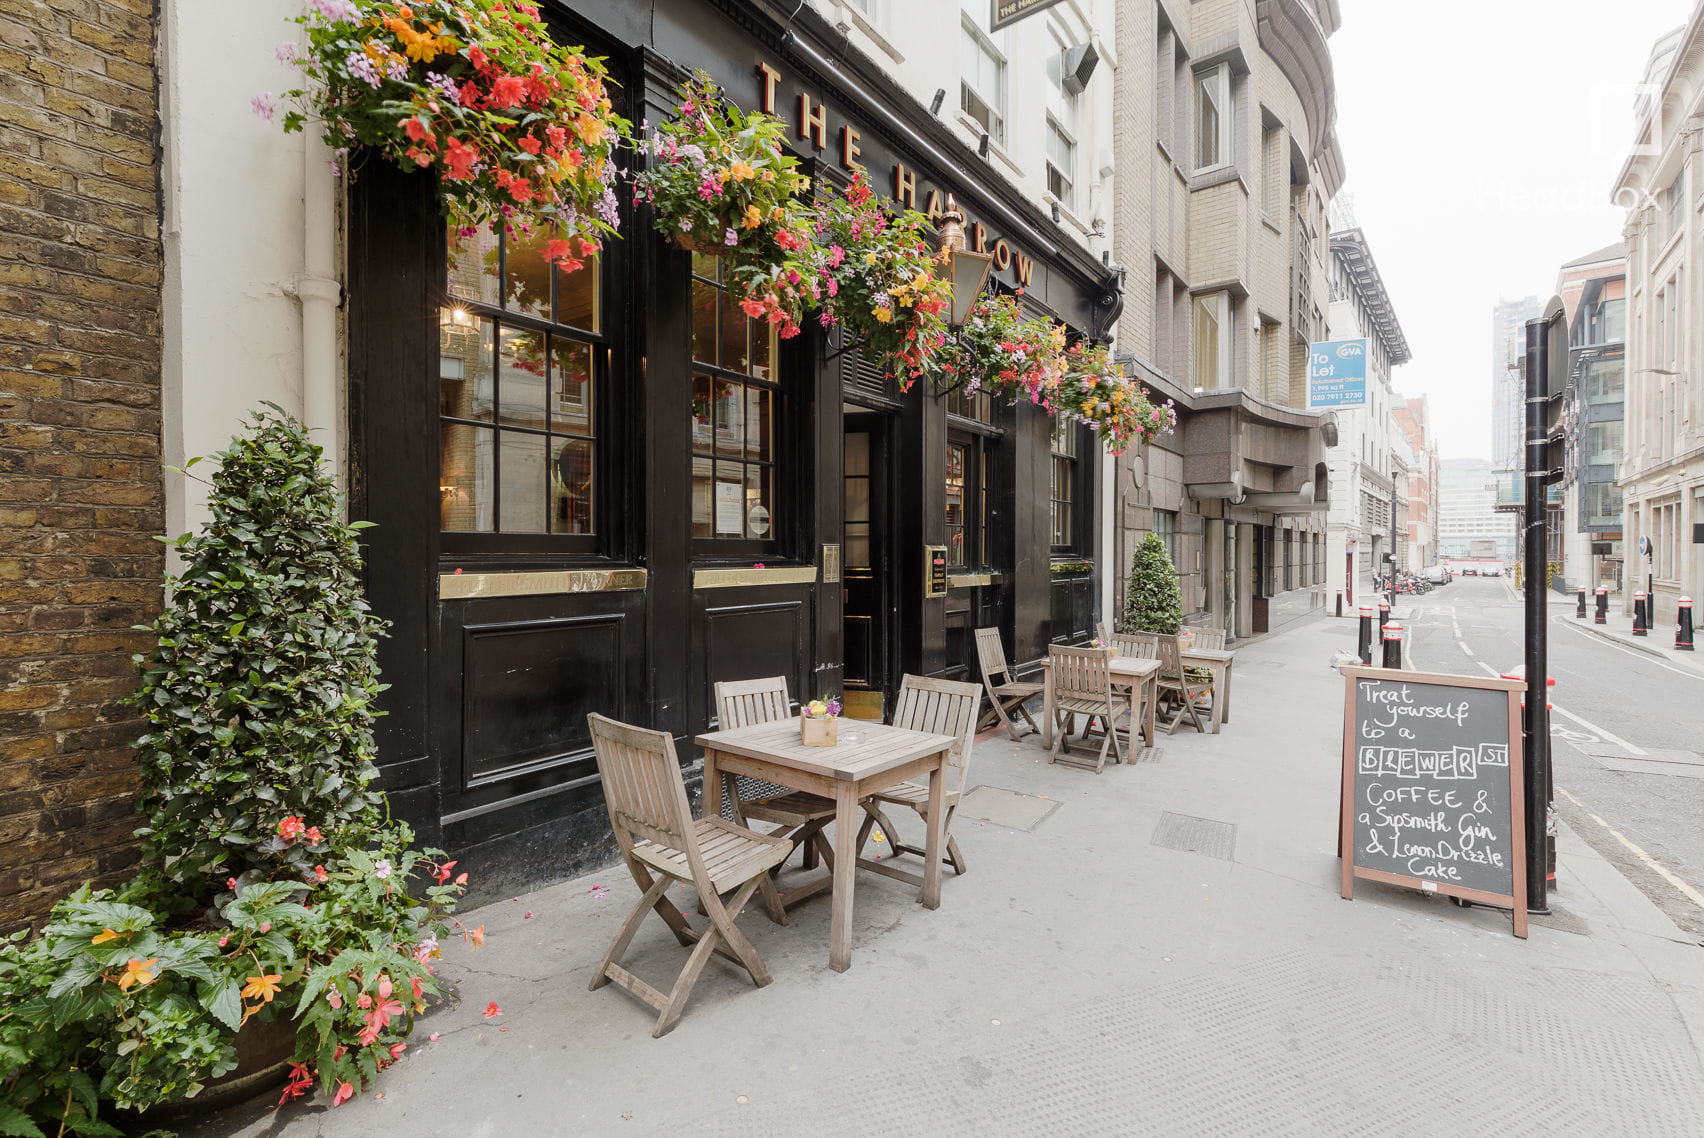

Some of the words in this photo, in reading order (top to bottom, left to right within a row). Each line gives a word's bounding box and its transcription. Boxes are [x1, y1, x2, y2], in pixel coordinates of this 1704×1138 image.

[1000, 3, 1017, 18] THE
[759, 61, 862, 170] THE
[1312, 353, 1329, 365] To
[1312, 364, 1335, 377] Let
[1360, 680, 1414, 704] Treat
[1374, 702, 1469, 727] yourself
[1362, 719, 1385, 739] to
[1398, 726, 1416, 739] a
[1361, 747, 1475, 777] BREWER
[1473, 789, 1492, 814] &
[1359, 813, 1371, 825] a
[1458, 813, 1496, 850] Gin
[1366, 829, 1386, 857] &
[1407, 858, 1462, 881] Cake
